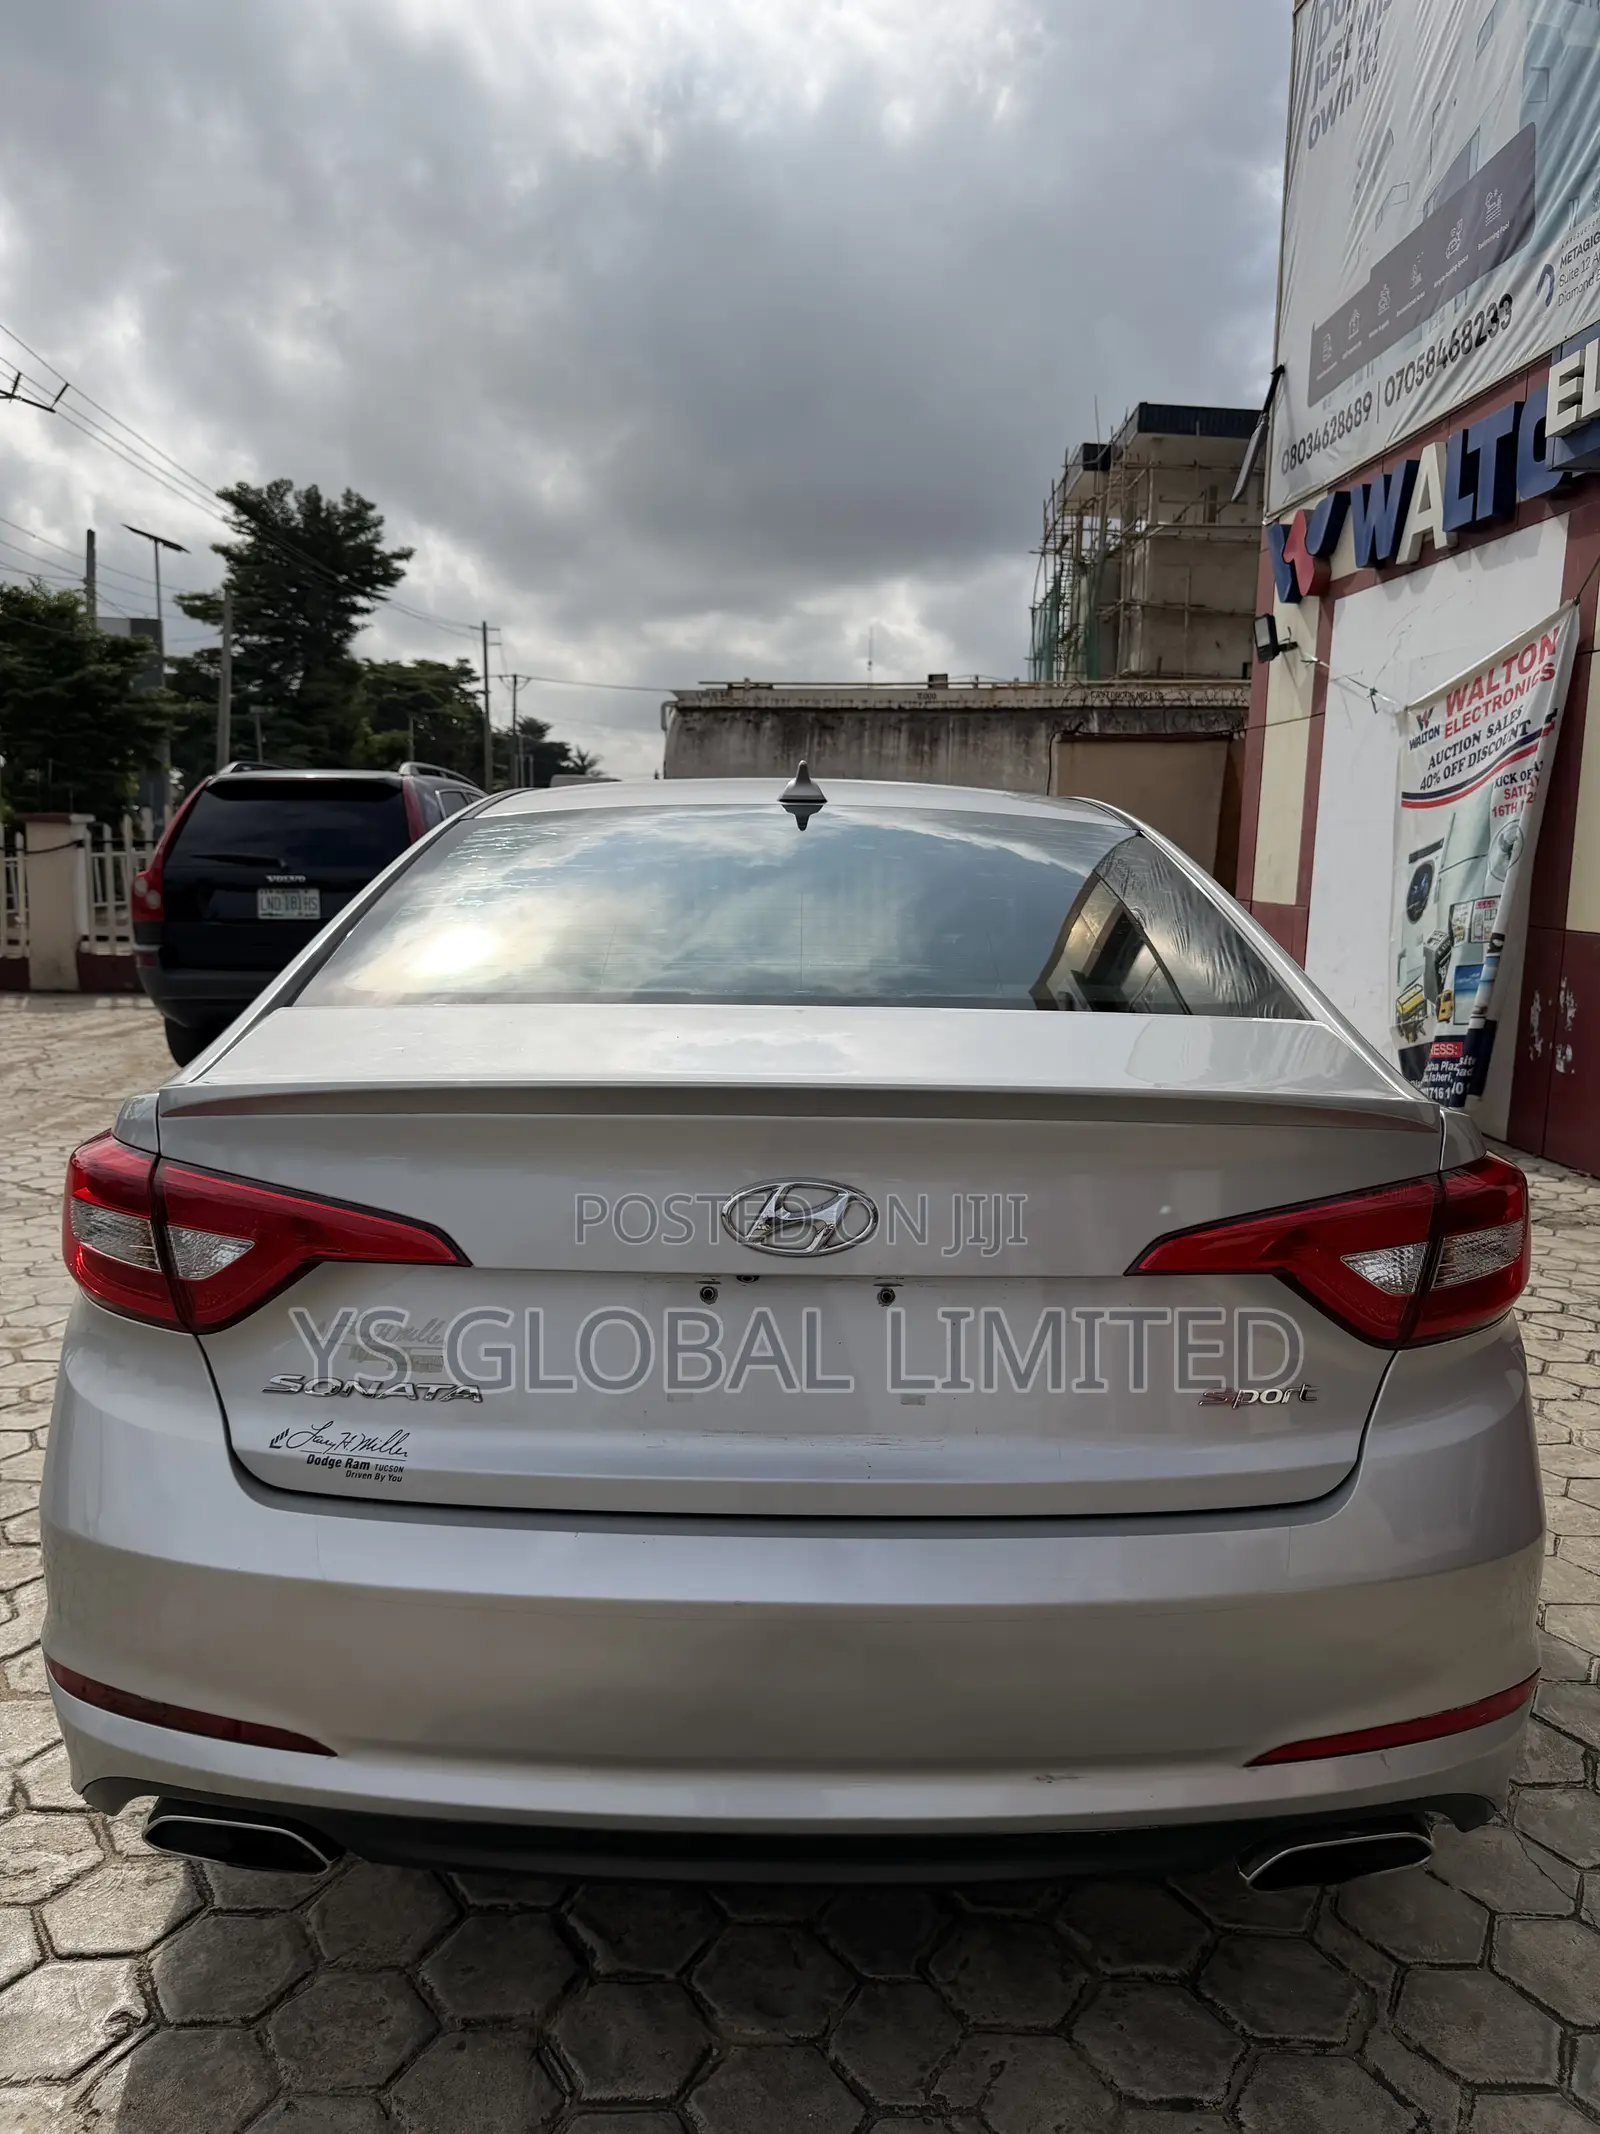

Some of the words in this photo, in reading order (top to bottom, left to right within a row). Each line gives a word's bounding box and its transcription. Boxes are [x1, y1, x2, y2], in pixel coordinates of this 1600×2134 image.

[1308, 73, 1353, 150] own
[1557, 272, 1595, 307] Diamond
[1558, 267, 1579, 288] Suite
[1580, 257, 1591, 274] 12
[1281, 391, 1373, 475] 08034628689
[1384, 293, 1513, 407] 07058468233
[1445, 626, 1562, 718] WALTON
[1408, 723, 1441, 751] WALTON
[1443, 662, 1557, 740] ELECTRONICS
[1427, 731, 1482, 771] AUCTION
[1486, 704, 1523, 739] SALES
[1419, 771, 1441, 792] 40%
[1443, 756, 1466, 782] OFF
[1468, 719, 1532, 768] DISCOUNT
[1492, 802, 1517, 818] 16TH
[265, 875, 306, 883] VOLVO
[261, 1374, 484, 1404] SONATA
[1198, 1383, 1319, 1410] Sport
[286, 1420, 337, 1455] Larry
[350, 1428, 409, 1458] Miller
[306, 1453, 342, 1470] Dodge
[344, 1457, 371, 1471] Ram
[373, 1463, 405, 1474] TUCSON
[344, 1469, 373, 1481] Driven
[373, 1472, 386, 1483] By
[387, 1472, 403, 1483] You
